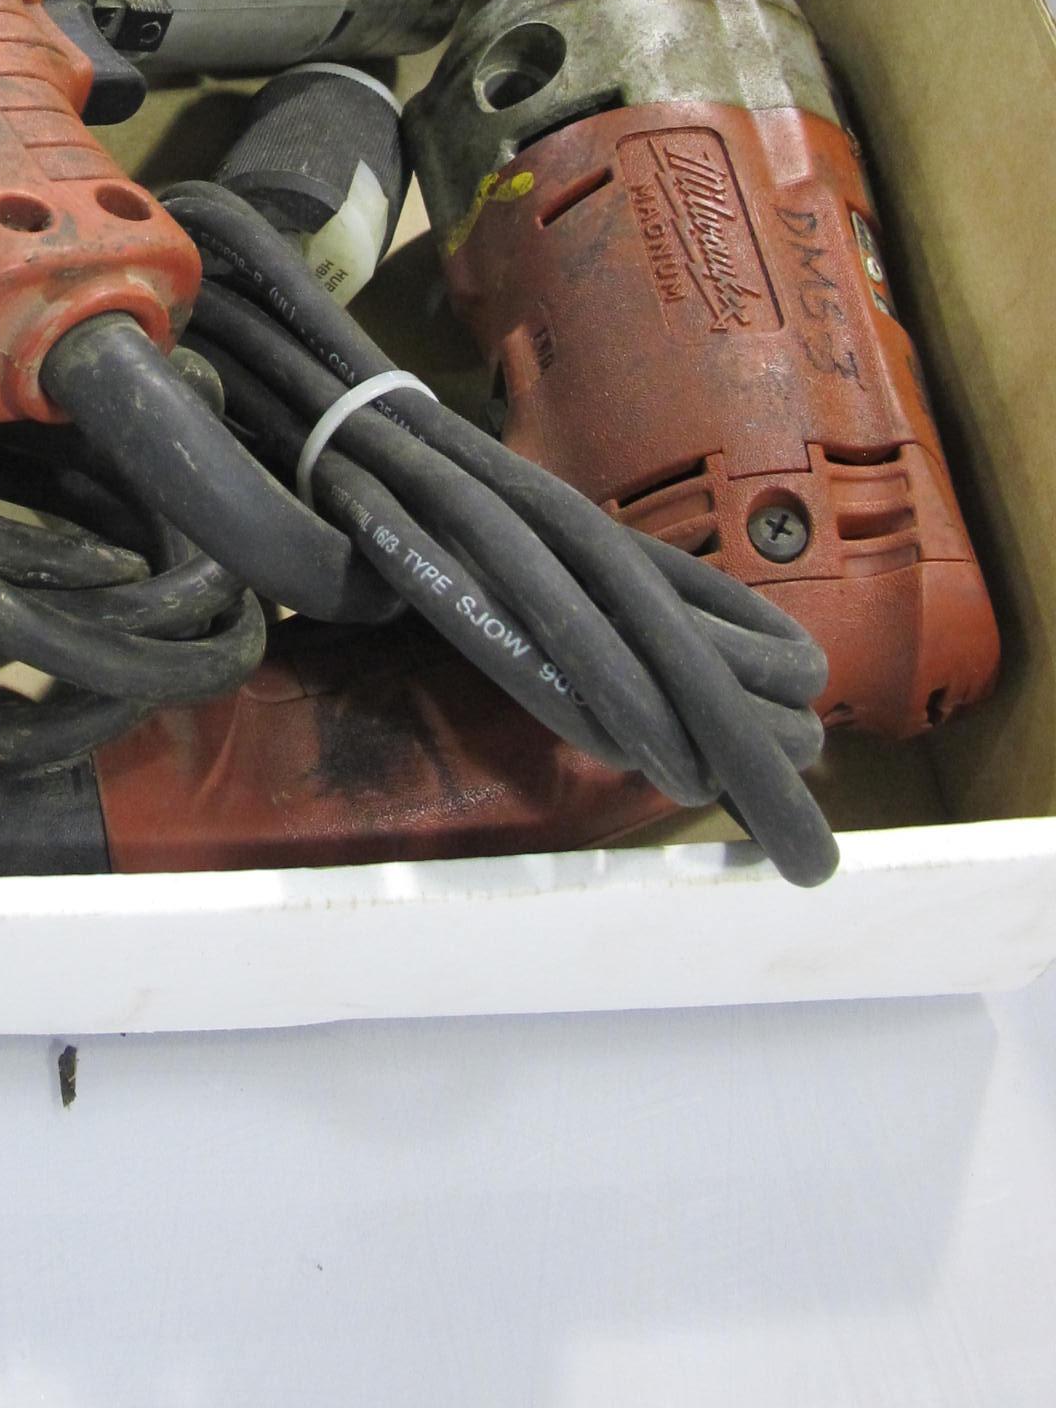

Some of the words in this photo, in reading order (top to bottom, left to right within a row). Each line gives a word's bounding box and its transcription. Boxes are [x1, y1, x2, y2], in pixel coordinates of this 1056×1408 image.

[630, 184, 687, 305] MAGNUM
[372, 525, 400, 553] 16/3
[403, 548, 453, 596] TYPE
[456, 594, 532, 659] SJOW
